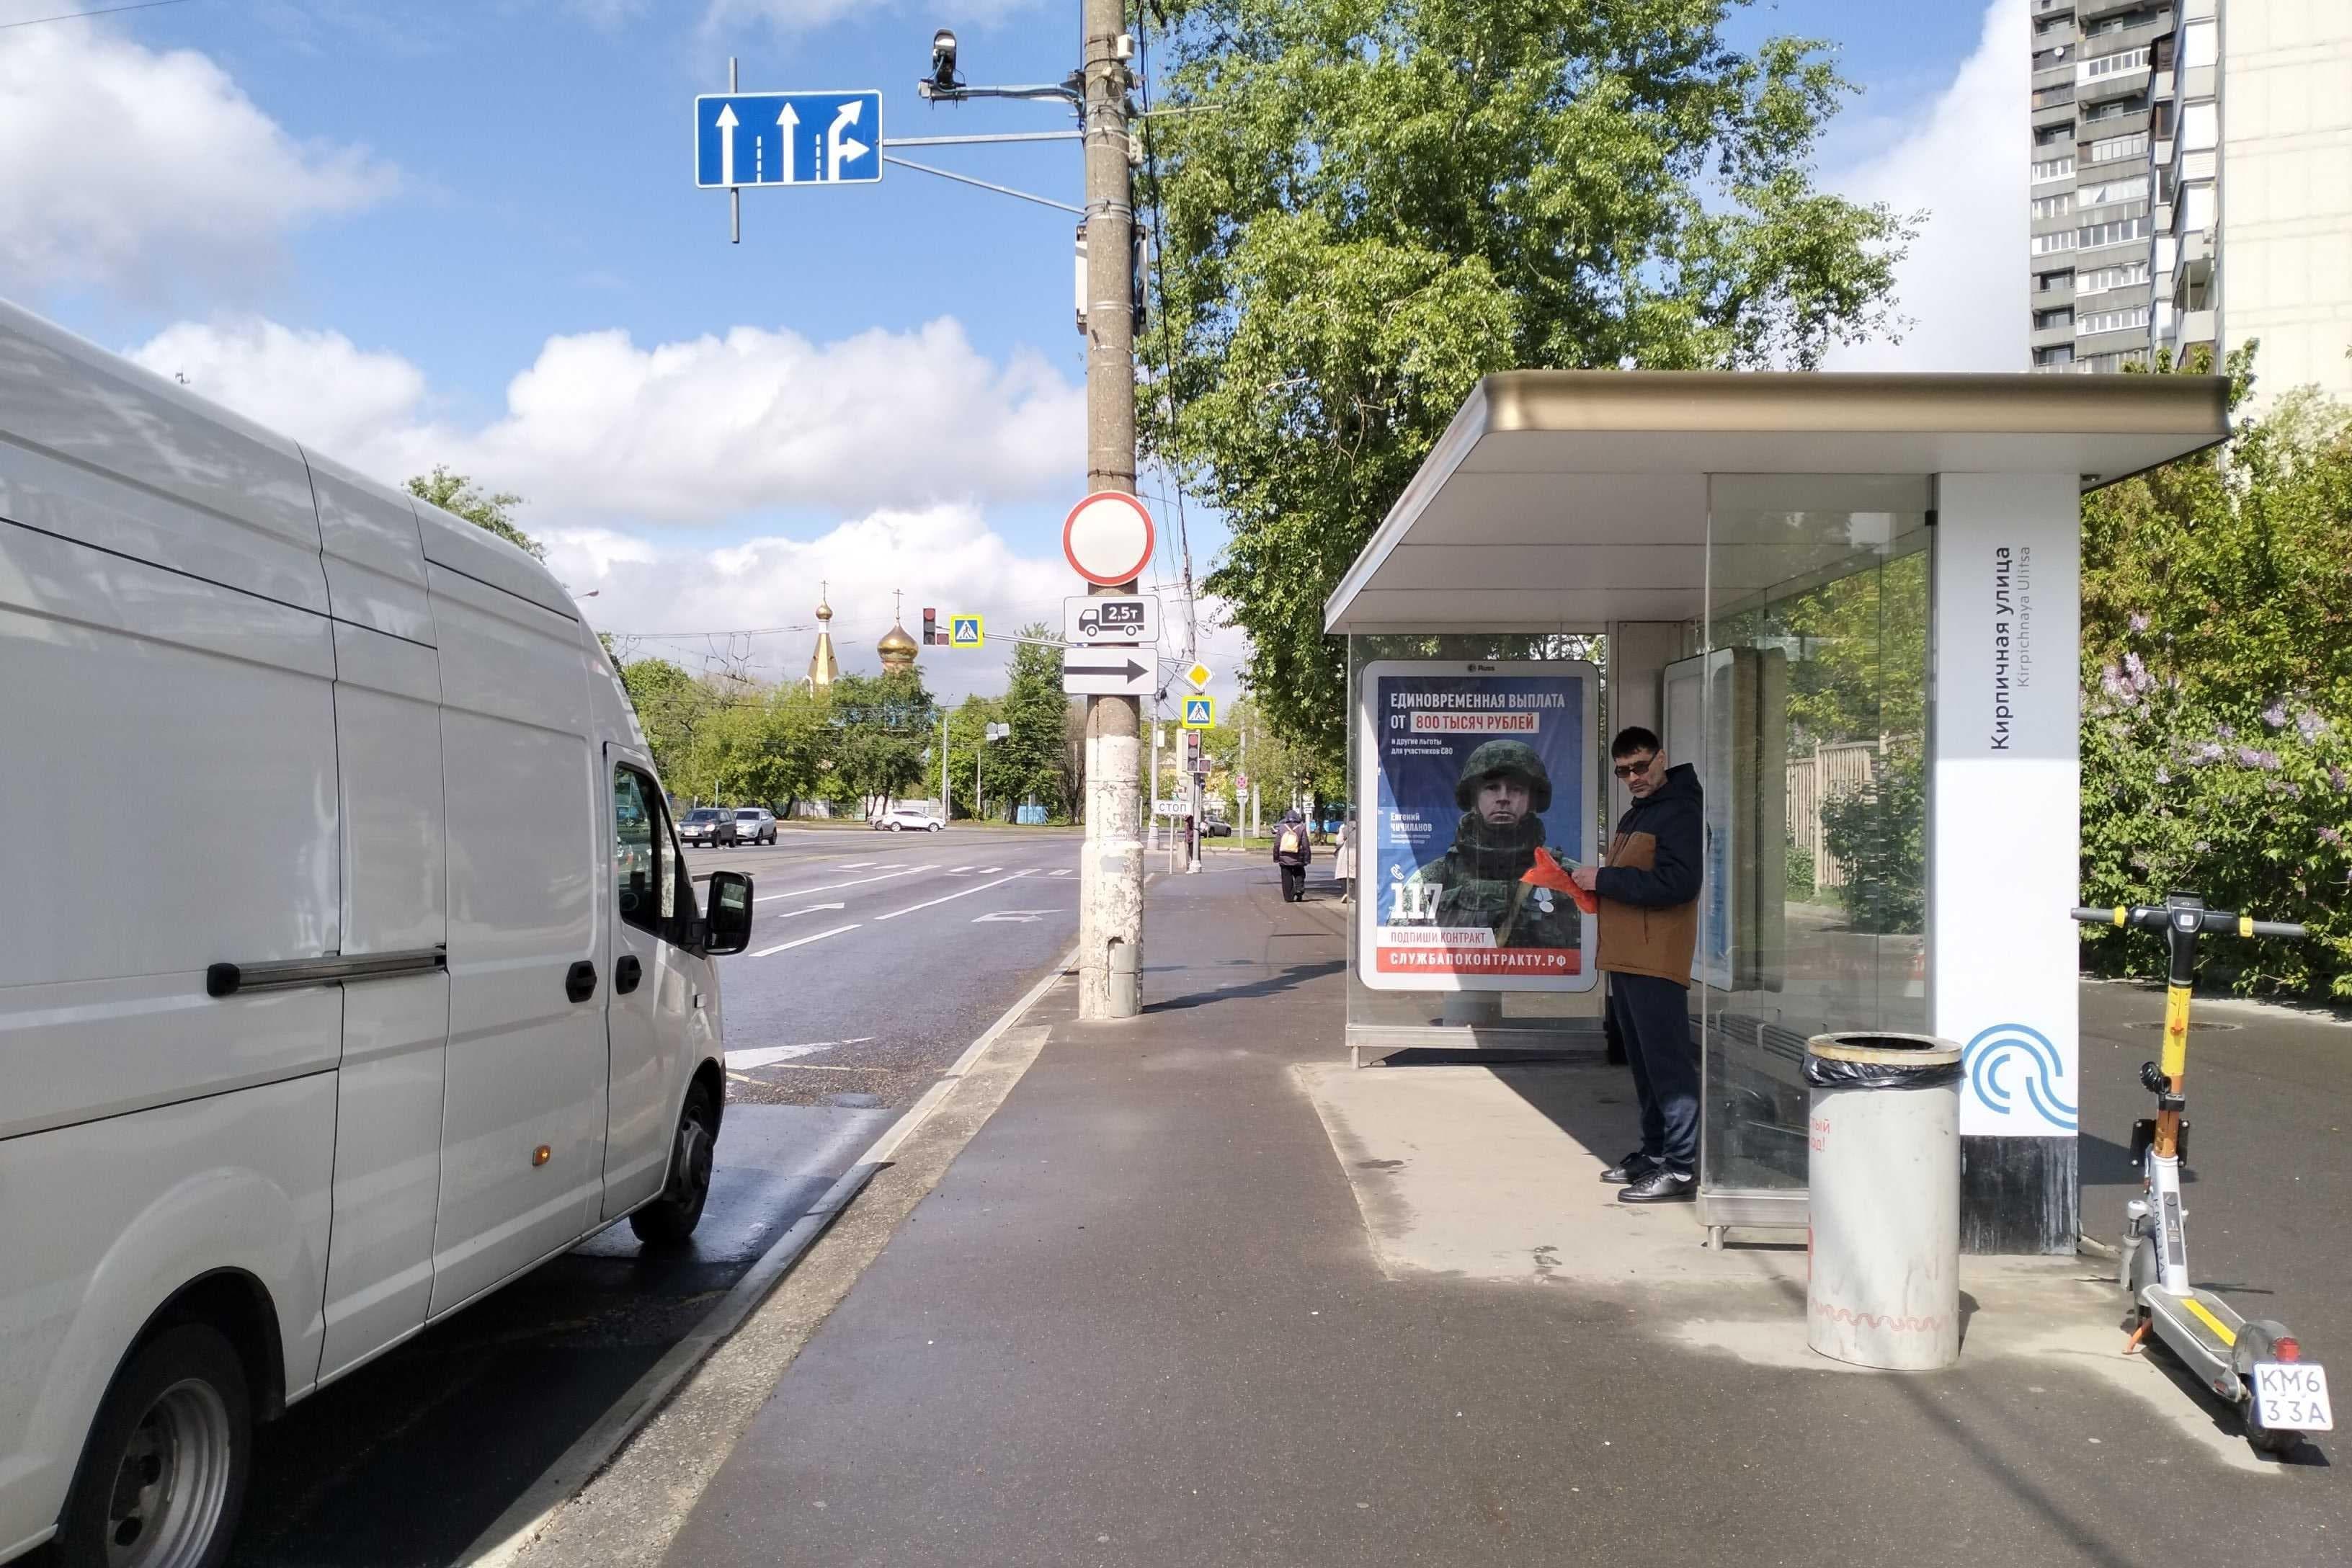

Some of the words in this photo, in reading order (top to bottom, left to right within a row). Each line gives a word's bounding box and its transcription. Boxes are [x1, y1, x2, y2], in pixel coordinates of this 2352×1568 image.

[2017, 547, 2030, 591] Ulitsa
[1995, 547, 2014, 615] улица
[2017, 595, 2033, 687] Kirpichnaya
[1991, 622, 2013, 749] Кирпичная
[1390, 692, 1505, 708] ЕДИНОВРЕМЕННАЯ
[1508, 693, 1565, 708] ВЫПЛАТА
[1391, 715, 1406, 729] ОТ
[1416, 715, 1440, 729] 800
[1442, 715, 1484, 729] ТЫСЯЧ
[1487, 713, 1534, 729] РУБЛЕЙ
[1396, 738, 1419, 747] другие
[1404, 747, 1440, 756] участников
[1159, 803, 1187, 813] СТОП
[1391, 883, 1443, 919] 117
[1391, 932, 1438, 944] ПОДПИШИ
[1440, 932, 1486, 944] КОНТРАКТ
[1389, 953, 1567, 966] СЛУЖБАПОКОНТРАКТУ.РФ
